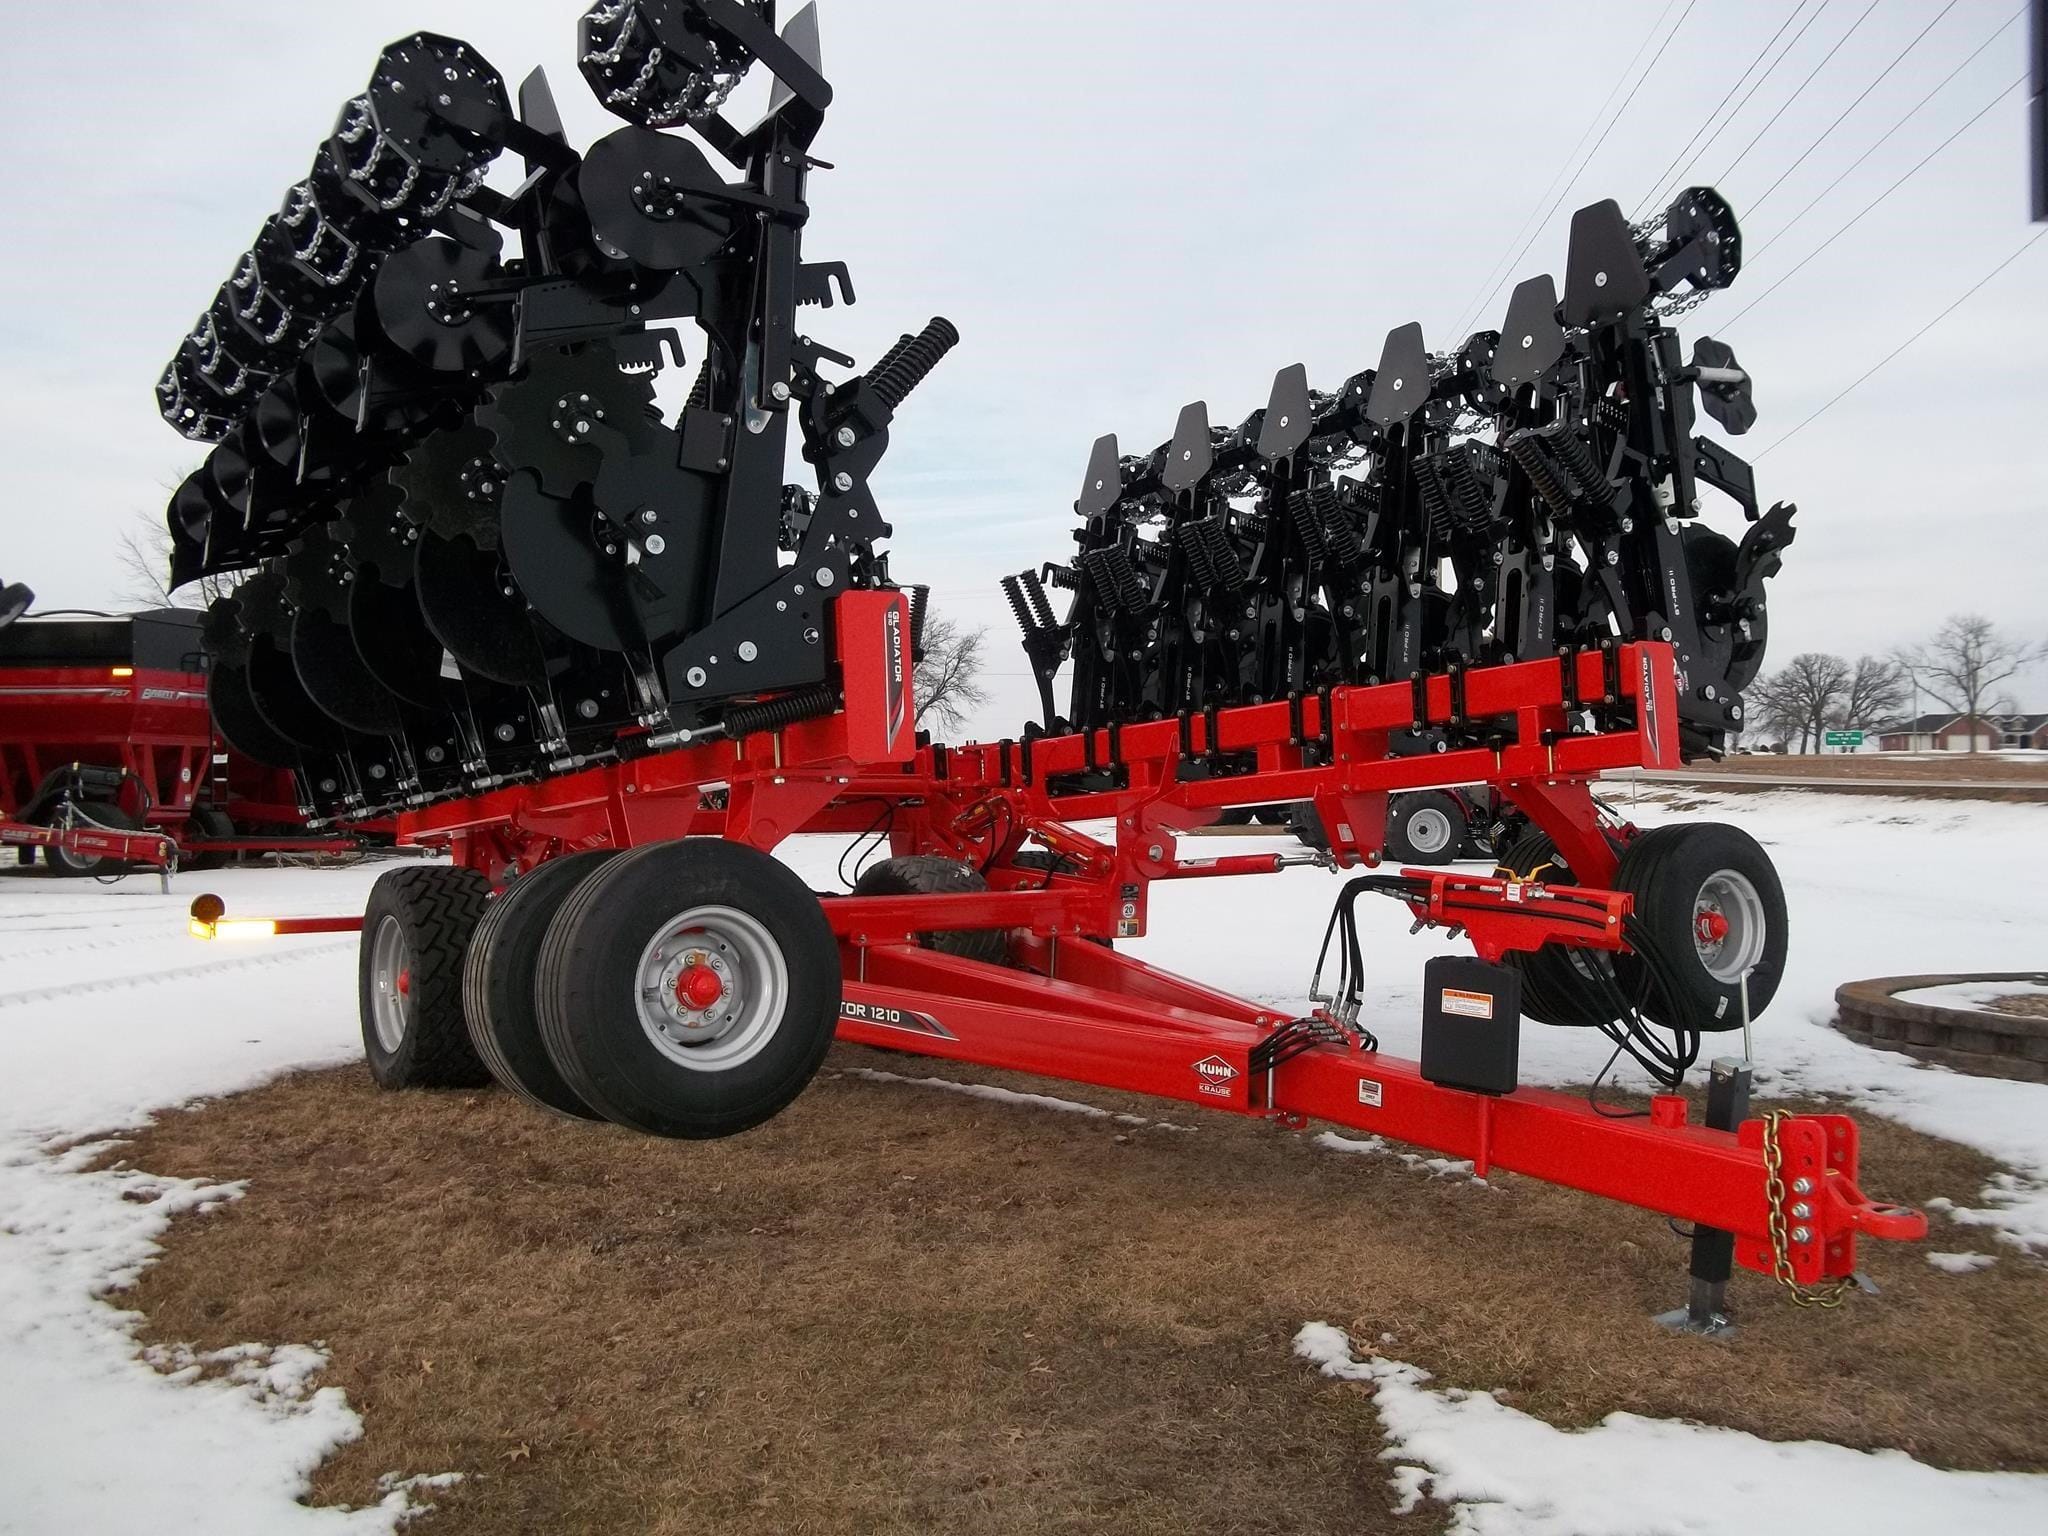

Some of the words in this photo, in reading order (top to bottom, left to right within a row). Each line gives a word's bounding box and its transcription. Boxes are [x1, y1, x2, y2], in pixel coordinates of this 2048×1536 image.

[1670, 578, 1680, 616] ST-PRO
[1537, 605, 1545, 640] ST-PRO
[892, 611, 903, 683] GLADIATOR
[1642, 657, 1651, 711] GLADIATOR
[1124, 905, 1134, 914] 20
[870, 1006, 900, 1023] 1210
[1199, 1063, 1232, 1078] KUHN
[1199, 1084, 1231, 1096] KRAUSE
